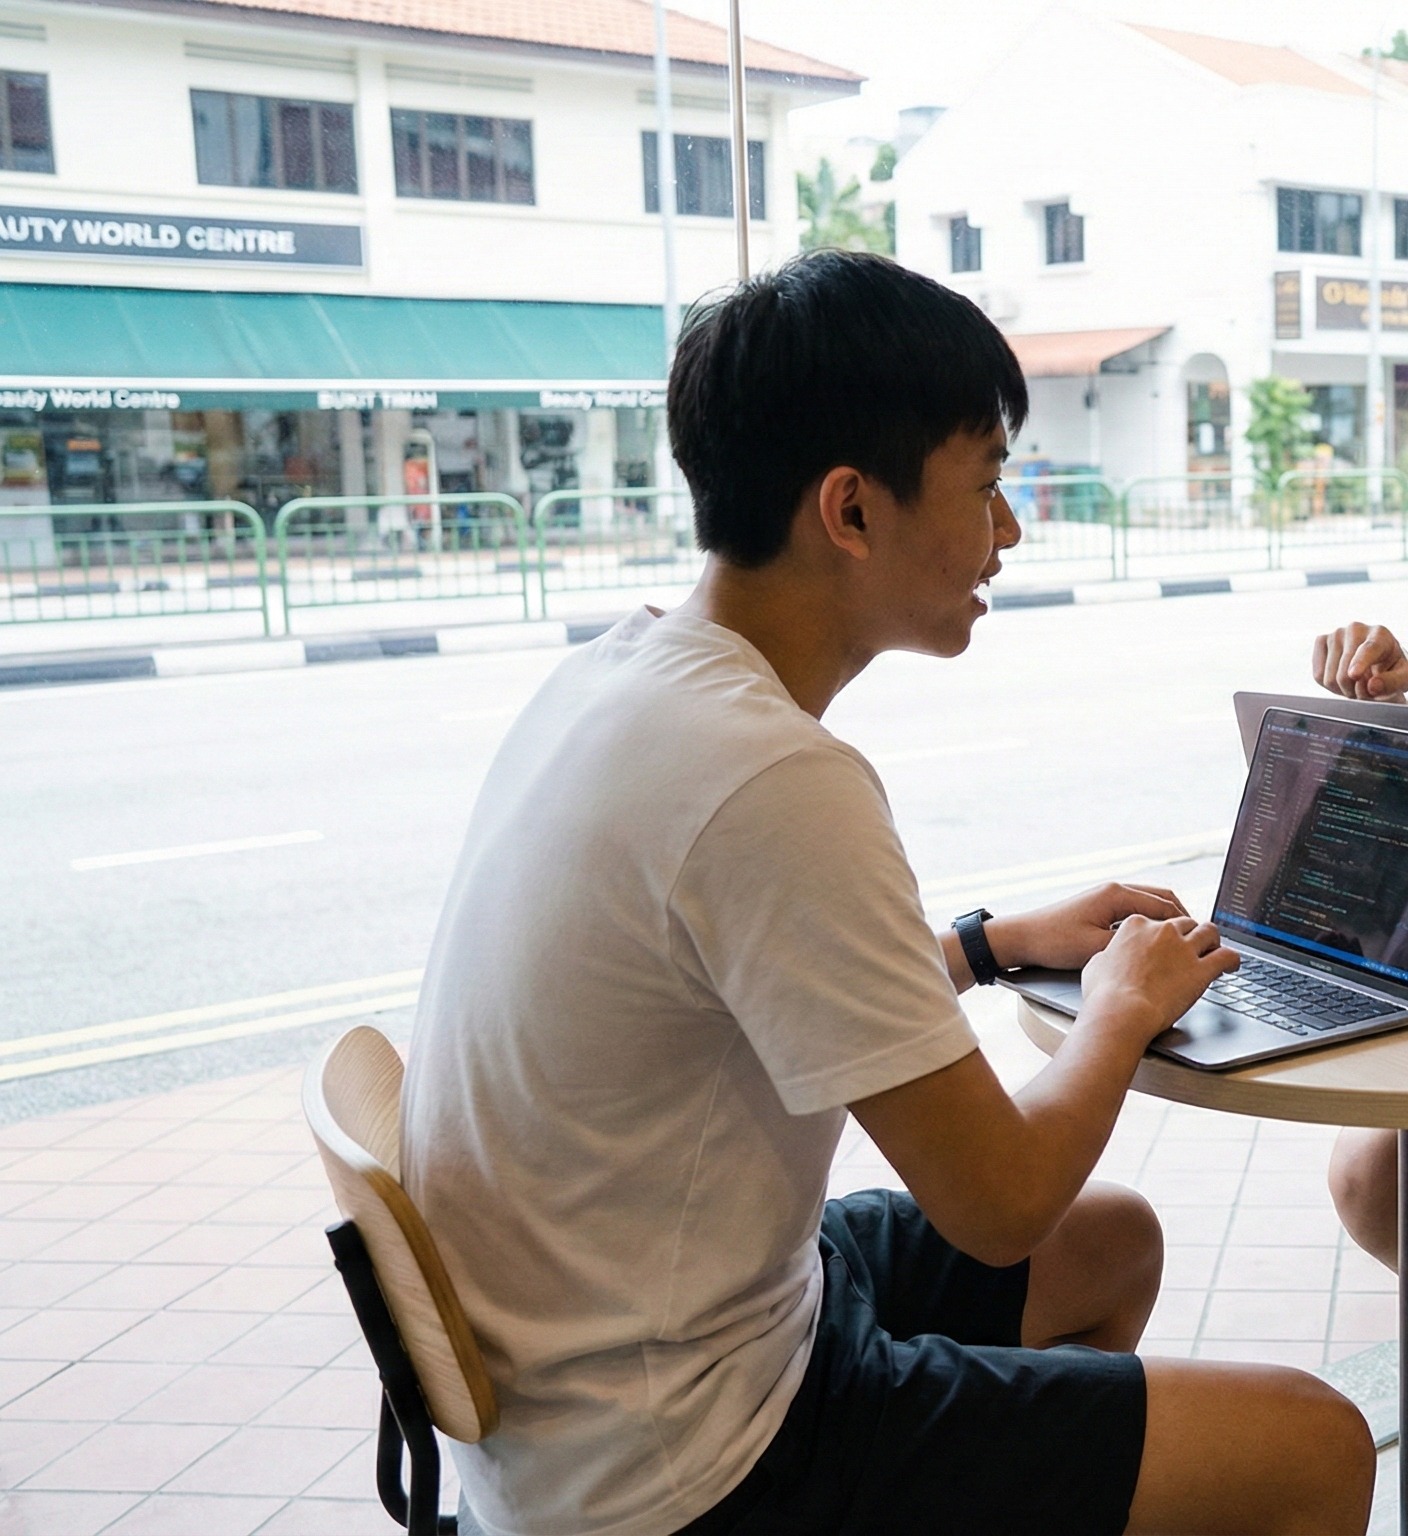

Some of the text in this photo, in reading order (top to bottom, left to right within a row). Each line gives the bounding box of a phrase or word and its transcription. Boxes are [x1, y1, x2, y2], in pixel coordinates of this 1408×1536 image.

[72, 219, 181, 249] WORLD
[186, 225, 297, 254] CENTRE
[0, 388, 181, 412] auty World Centre
